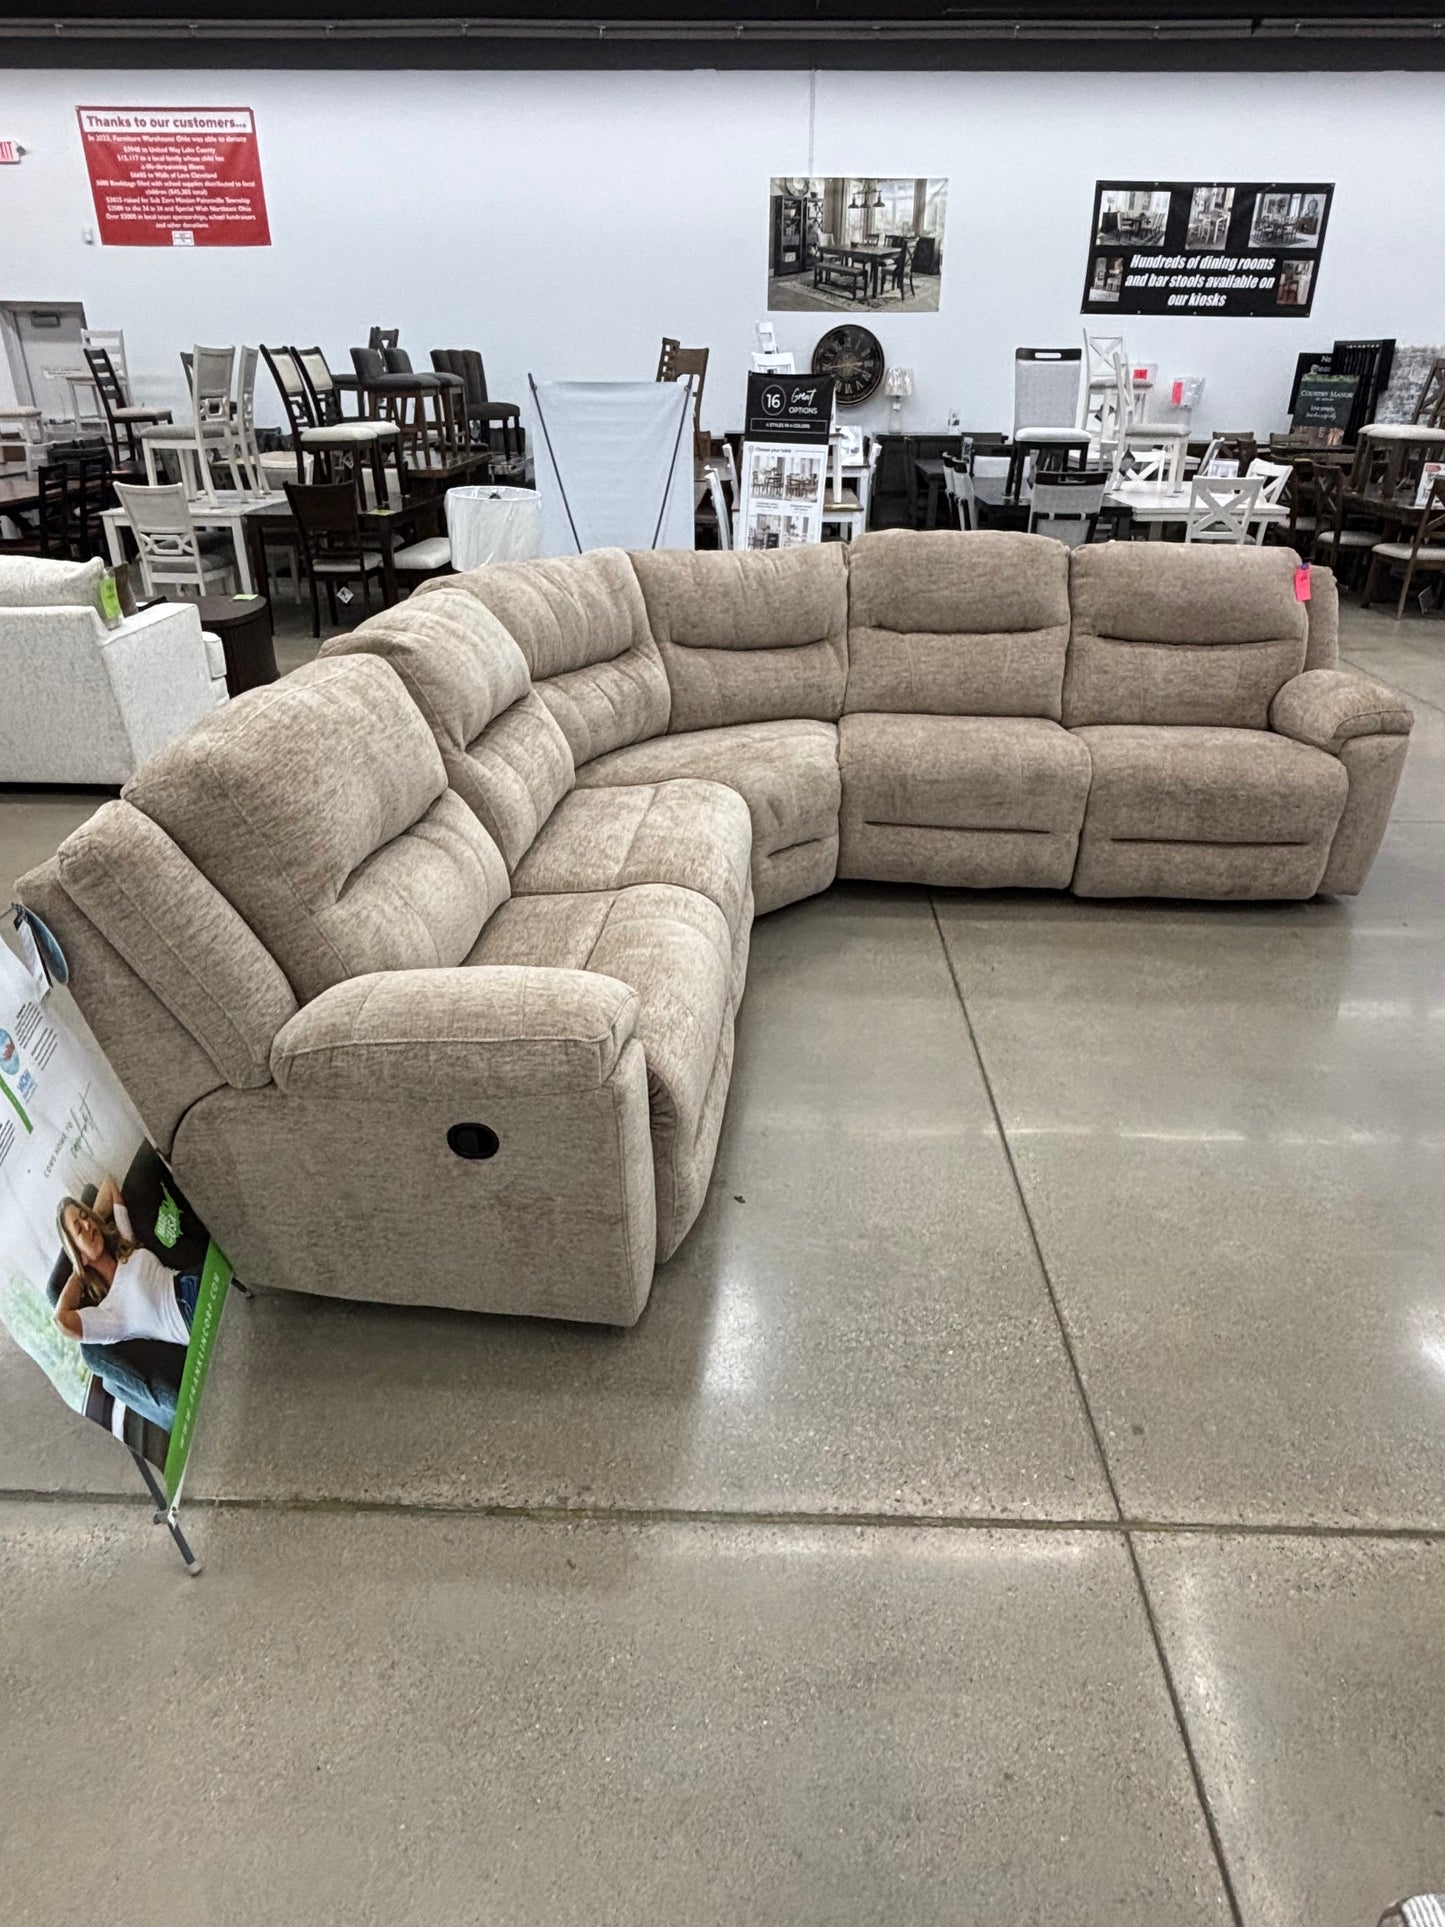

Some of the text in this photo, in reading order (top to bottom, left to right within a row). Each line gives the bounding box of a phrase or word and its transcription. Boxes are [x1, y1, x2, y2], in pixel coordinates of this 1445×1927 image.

[86, 115, 131, 128] Thanks
[134, 116, 146, 128] to
[150, 118, 171, 128] our
[0, 141, 14, 160] XIT
[1130, 254, 1276, 271] Hundreds of dining rooms
[1124, 274, 1275, 289] and bar stools available on
[1167, 293, 1227, 307] our kiosks
[766, 394, 781, 408] 16
[791, 387, 817, 406] Great
